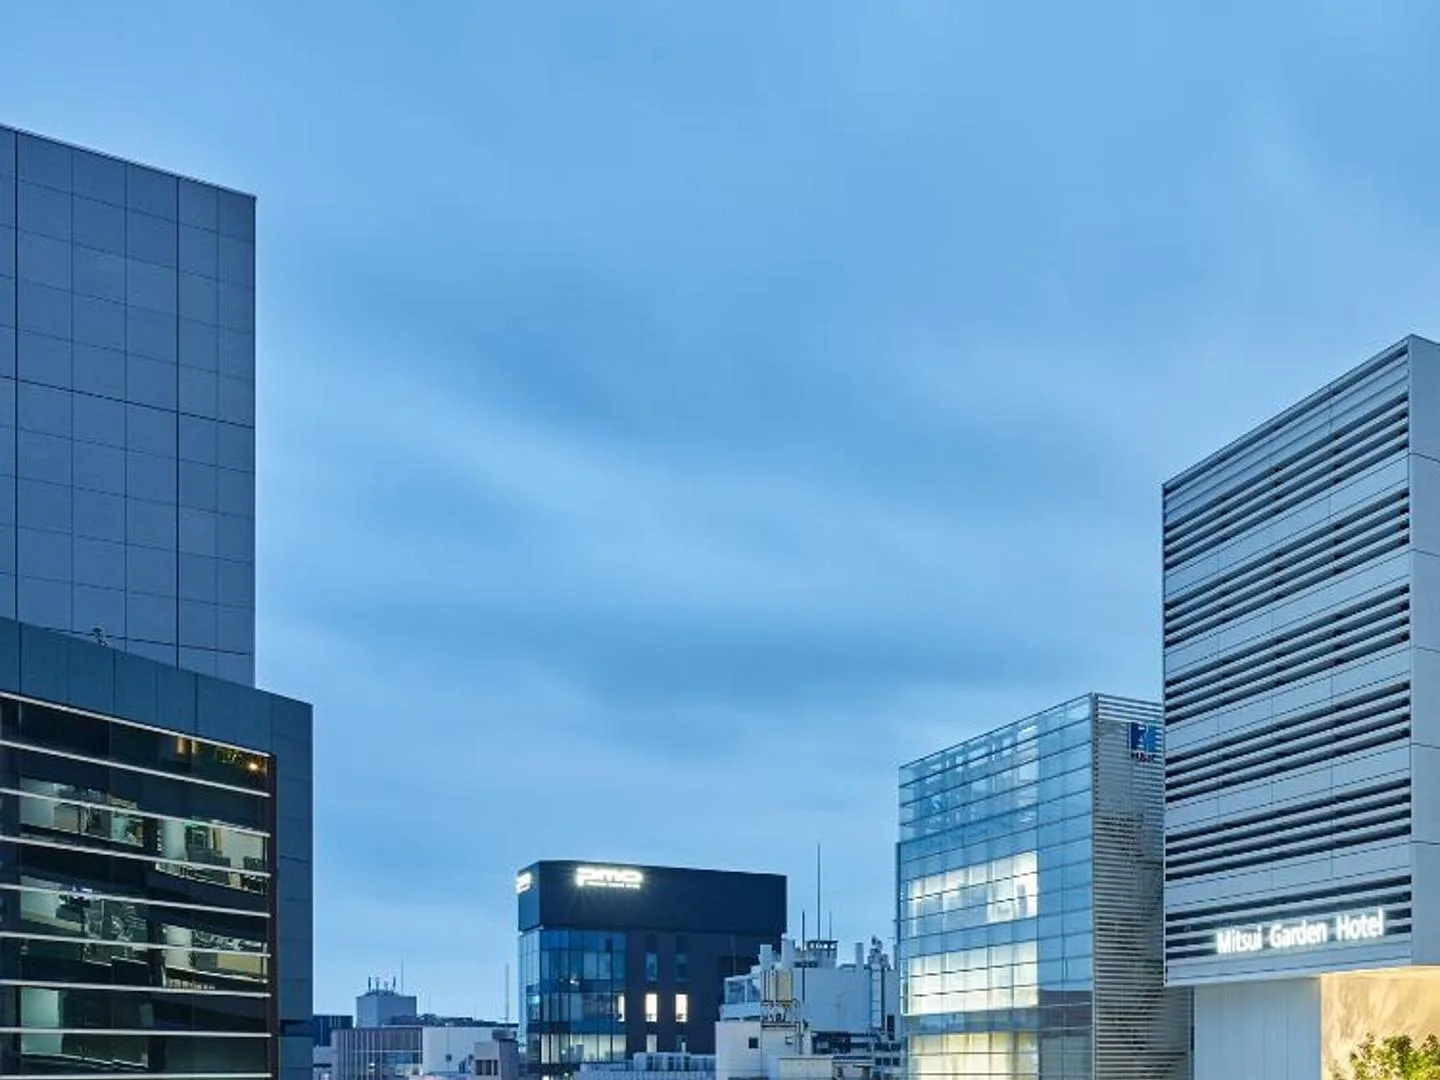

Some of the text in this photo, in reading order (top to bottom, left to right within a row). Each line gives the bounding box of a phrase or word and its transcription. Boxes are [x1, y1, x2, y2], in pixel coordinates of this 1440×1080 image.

[1216, 907, 1384, 954] Mitsui Garden Hotel
